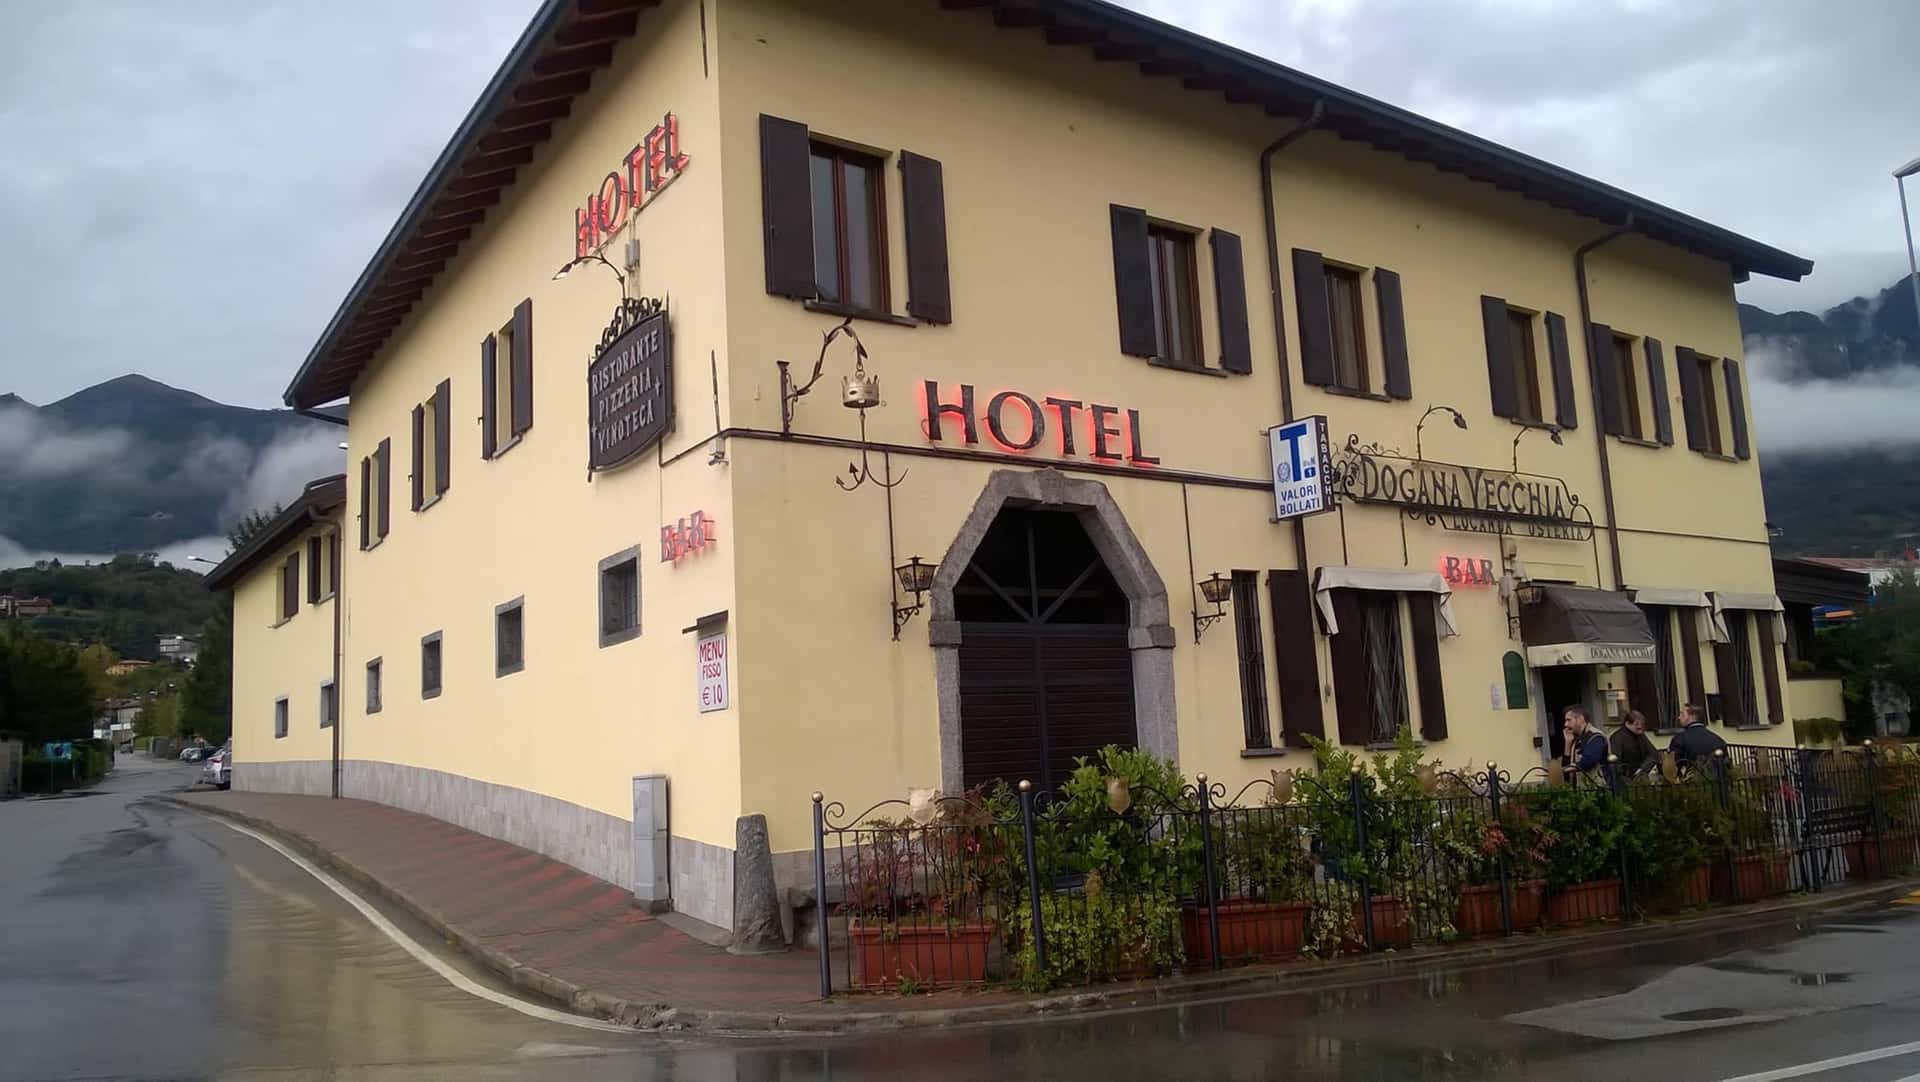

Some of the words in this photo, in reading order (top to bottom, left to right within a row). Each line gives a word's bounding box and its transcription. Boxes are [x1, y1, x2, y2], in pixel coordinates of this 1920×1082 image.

[576, 111, 689, 258] HOTEL
[591, 328, 659, 397] RISTORANTE
[599, 366, 652, 423] PIZZERIA
[925, 380, 1161, 465] HOTEL
[599, 399, 654, 454] VINOTECA
[1279, 423, 1307, 482] T
[1319, 422, 1332, 506] TABACCHI
[1360, 454, 1462, 509] DOGANA
[1463, 466, 1566, 520] VECCHIA
[1280, 497, 1320, 515] BOLLATI
[1281, 484, 1317, 502] VALORI
[660, 509, 706, 563] BAR
[1445, 556, 1497, 586] BAR
[700, 639, 724, 663] MENU
[702, 661, 721, 681] FISSO
